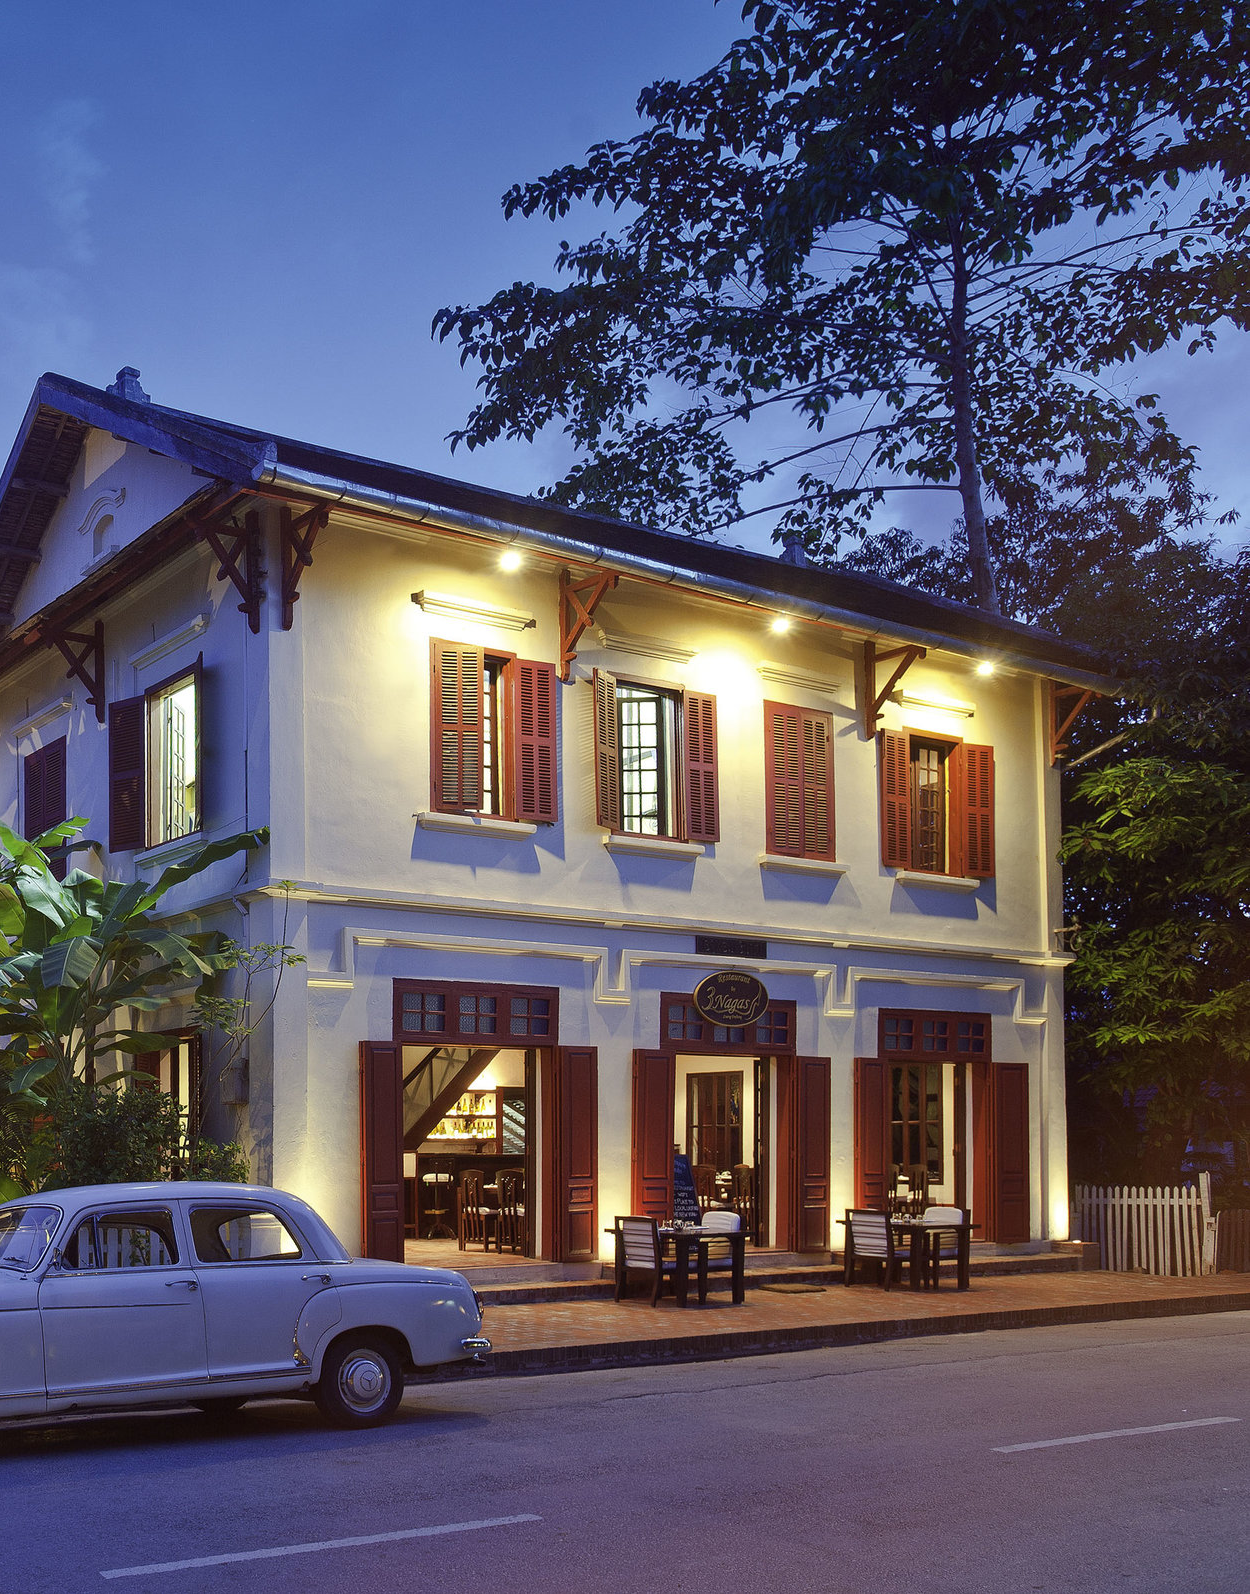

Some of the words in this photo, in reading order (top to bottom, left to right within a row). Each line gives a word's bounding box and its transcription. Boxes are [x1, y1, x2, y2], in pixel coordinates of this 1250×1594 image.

[717, 974, 751, 984] Restaurant
[701, 986, 716, 1011] 3
[712, 994, 751, 1014] Nagas
